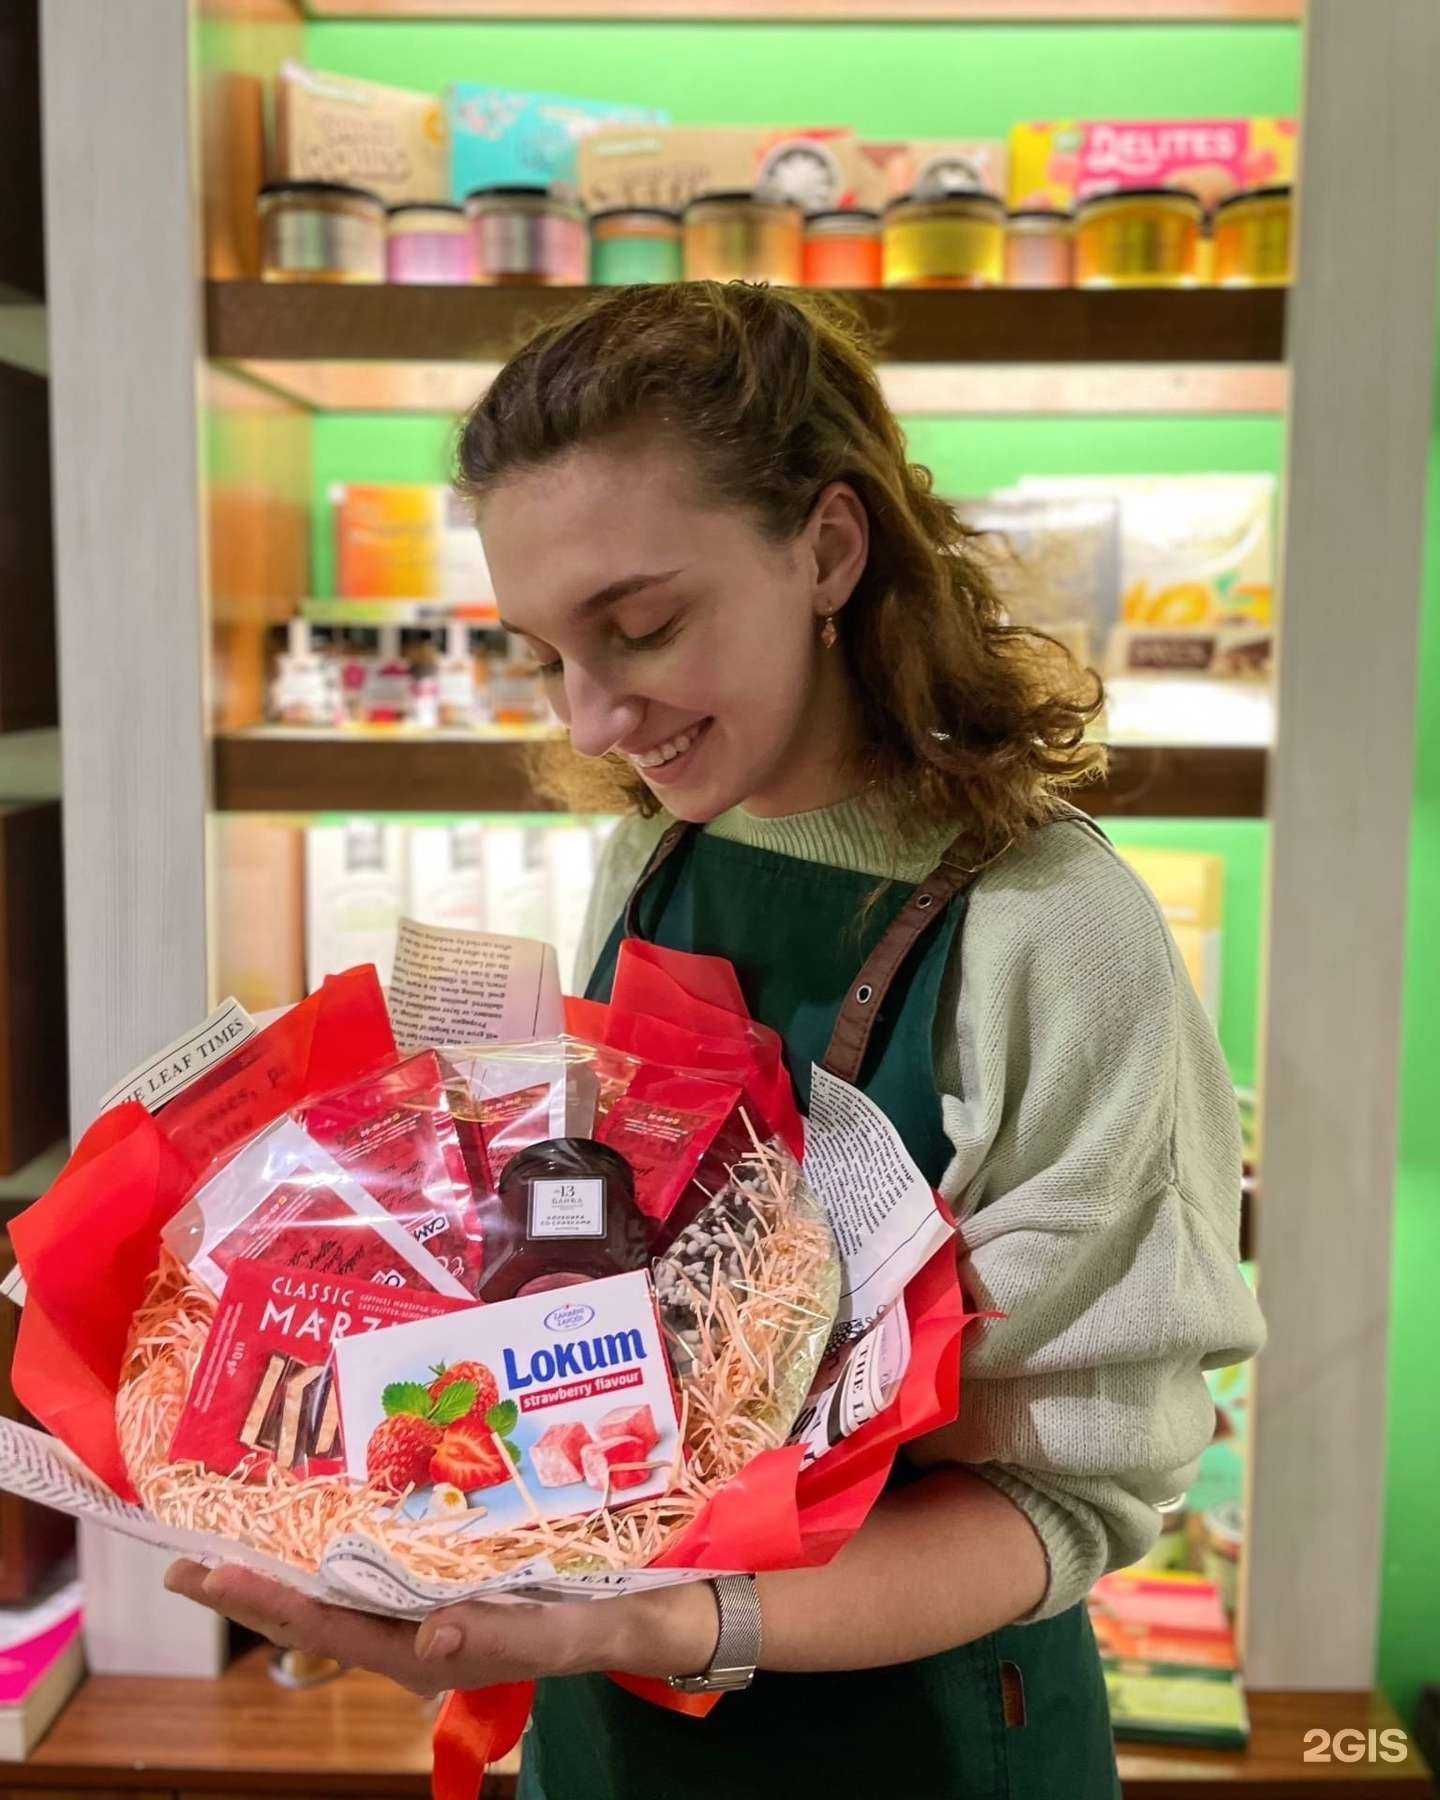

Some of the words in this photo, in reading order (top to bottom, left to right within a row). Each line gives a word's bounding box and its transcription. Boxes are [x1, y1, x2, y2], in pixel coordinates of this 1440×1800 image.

[147, 1052, 193, 1092] LEAF
[196, 1017, 245, 1059] TIMES
[271, 1276, 355, 1306] CLASSIC
[258, 1298, 400, 1344] MARZ
[523, 1383, 592, 1408] strawberry
[594, 1371, 640, 1391] flavour
